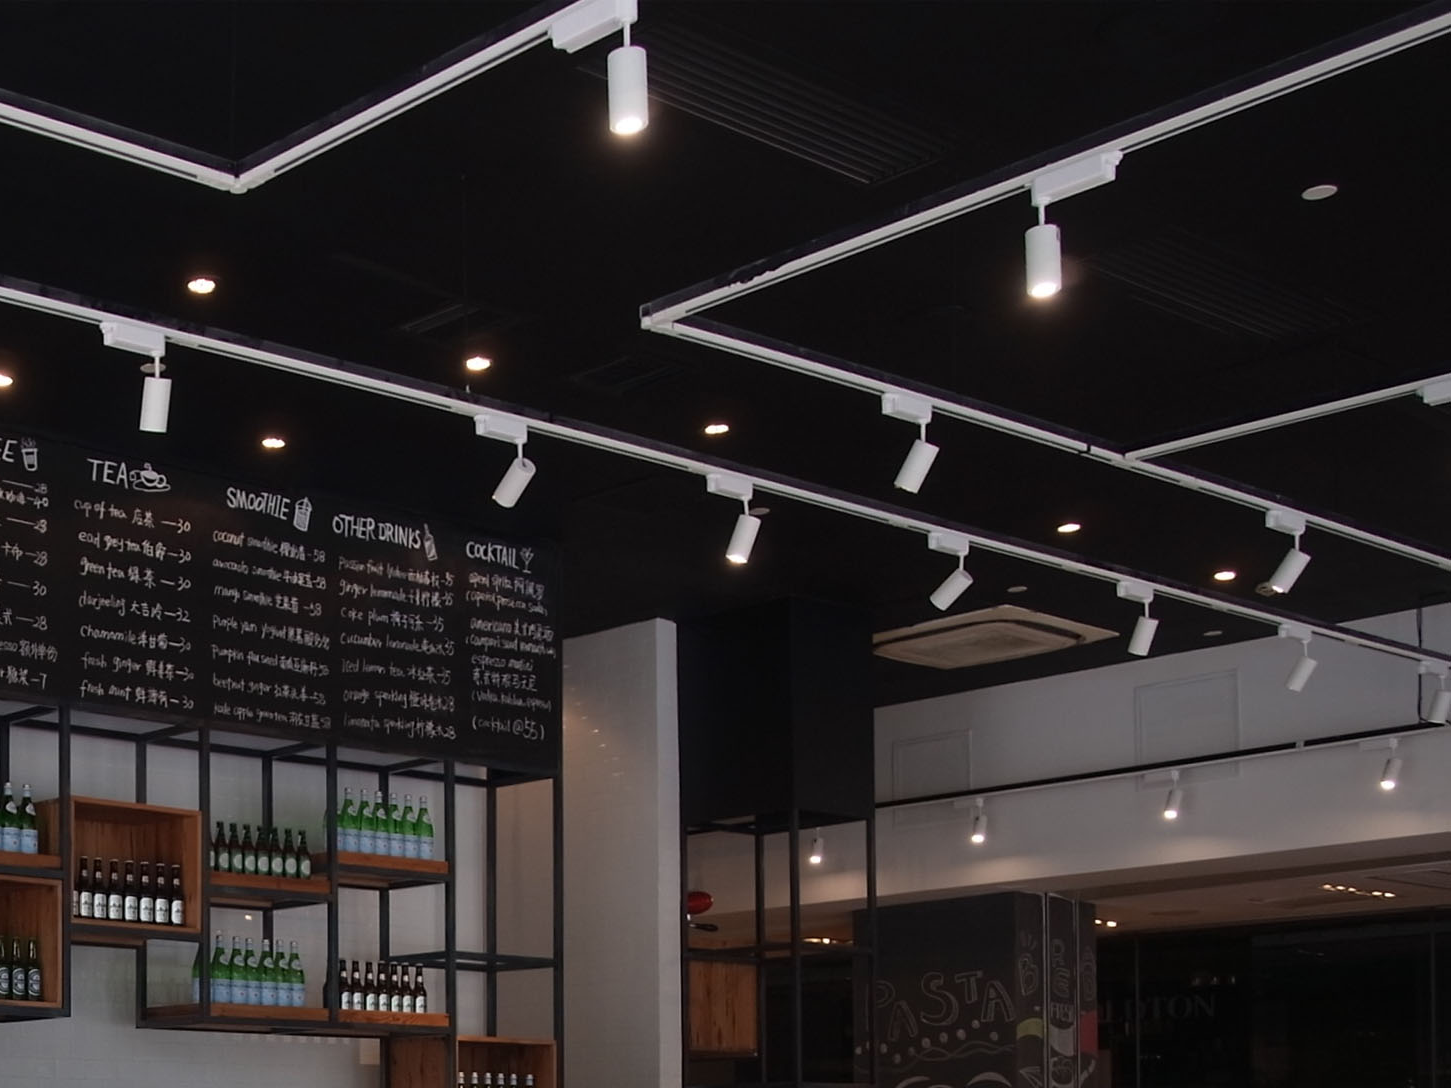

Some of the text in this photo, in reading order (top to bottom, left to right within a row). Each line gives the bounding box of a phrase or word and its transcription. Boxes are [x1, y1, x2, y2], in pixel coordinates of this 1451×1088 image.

[87, 458, 128, 489] TEA
[227, 487, 290, 520] SMOOTHIE
[332, 514, 421, 549] OTHER DRINKS
[466, 541, 520, 570] COCKTAIL
[865, 969, 1015, 1042] PASTA
